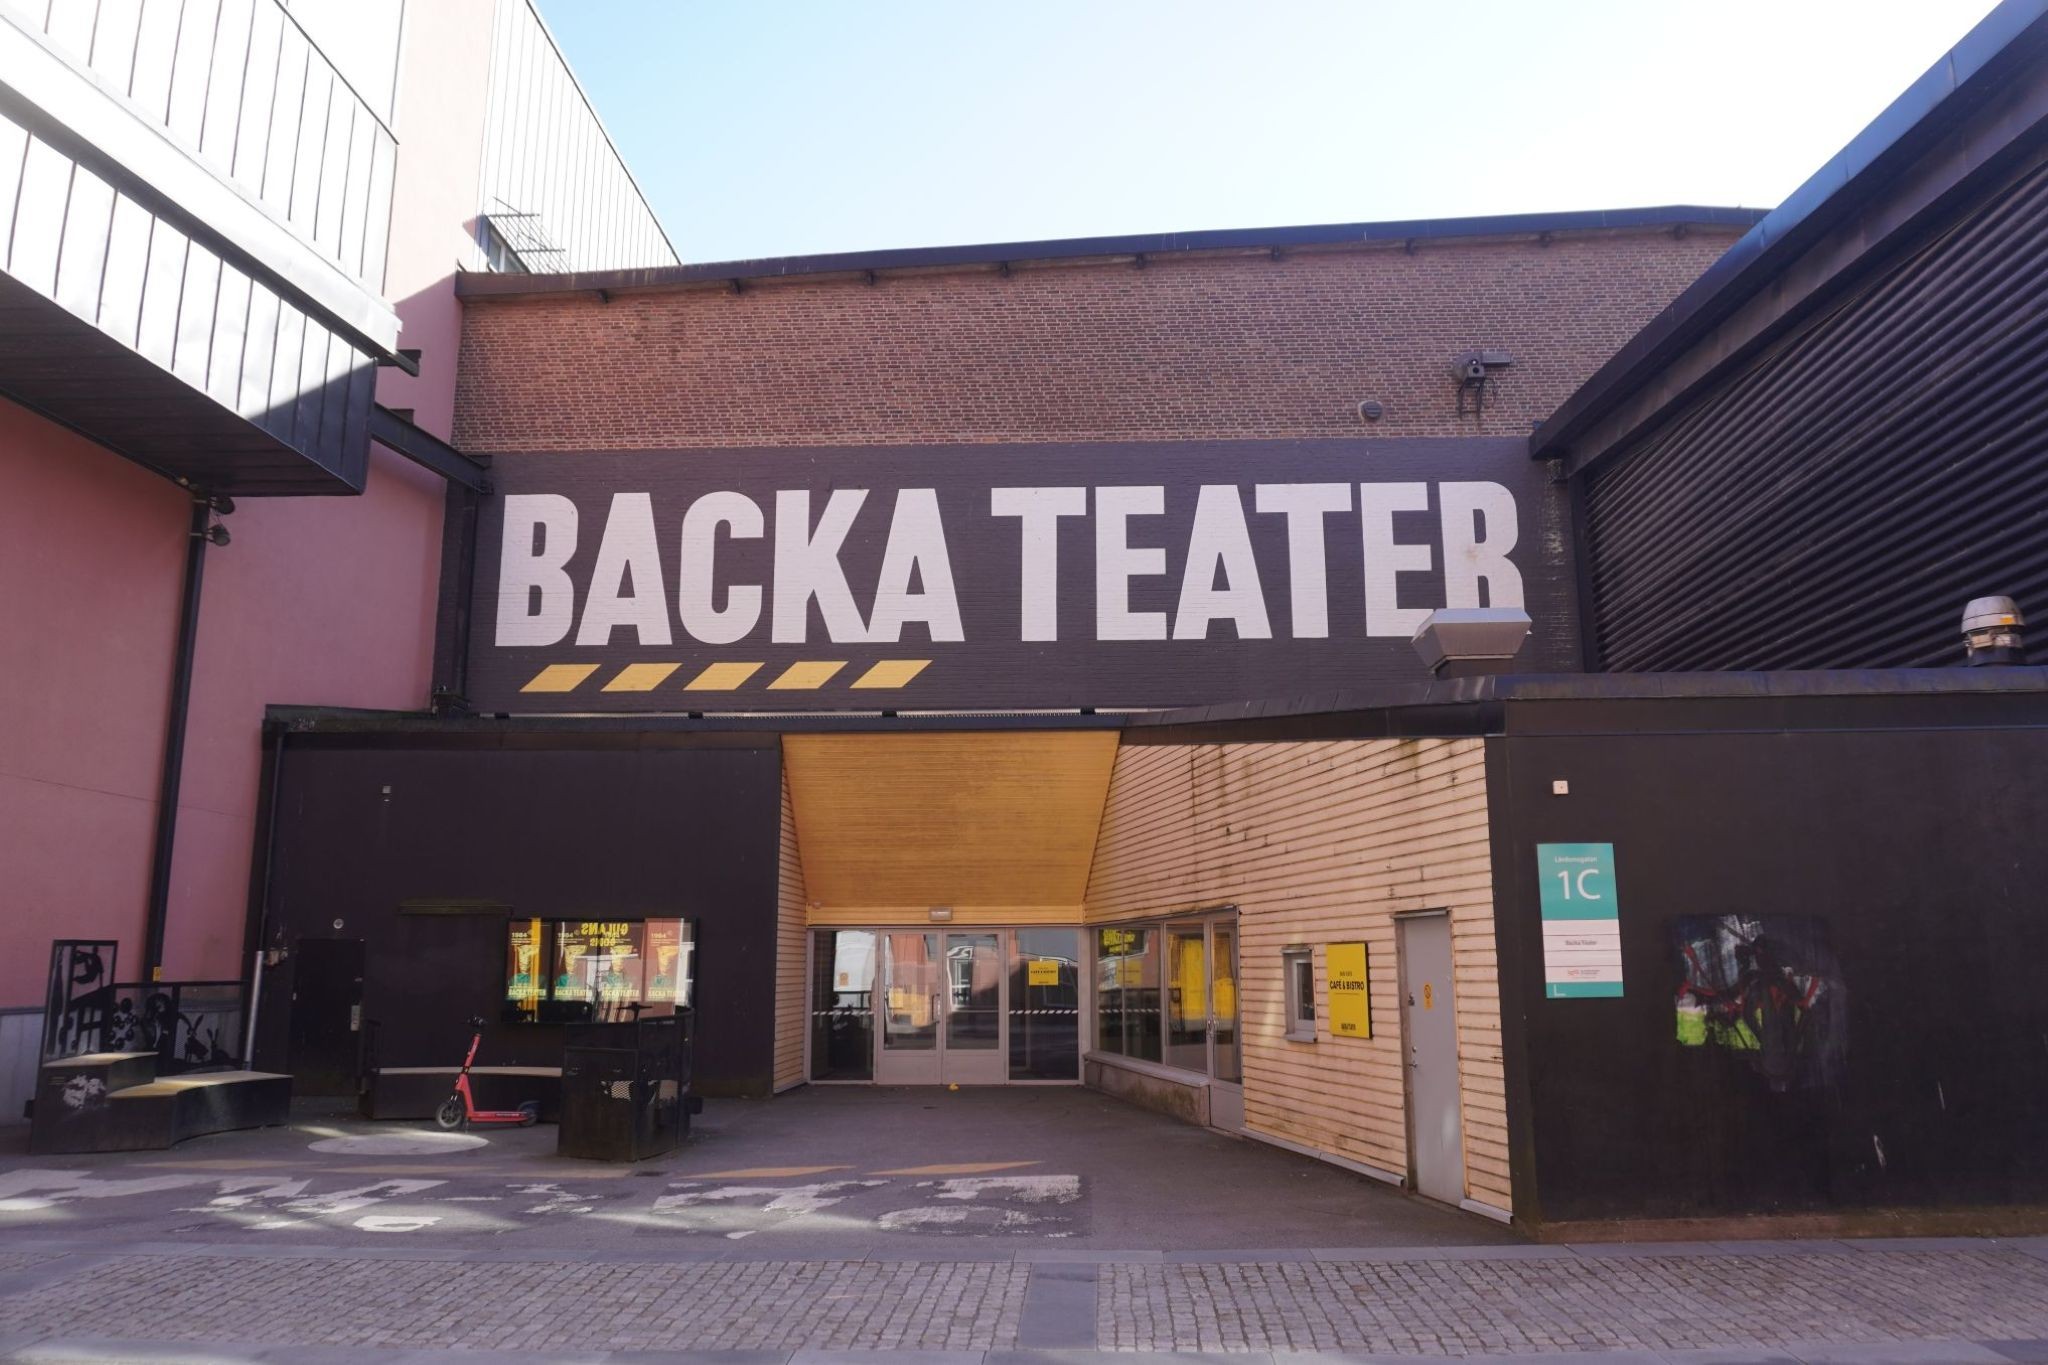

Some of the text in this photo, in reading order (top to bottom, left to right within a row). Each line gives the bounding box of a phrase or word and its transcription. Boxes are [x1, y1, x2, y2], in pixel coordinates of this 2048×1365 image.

[495, 481, 1532, 646] BACKA TEATER
[1557, 868, 1601, 900] 1C
[1346, 980, 1365, 991] BISTRO
